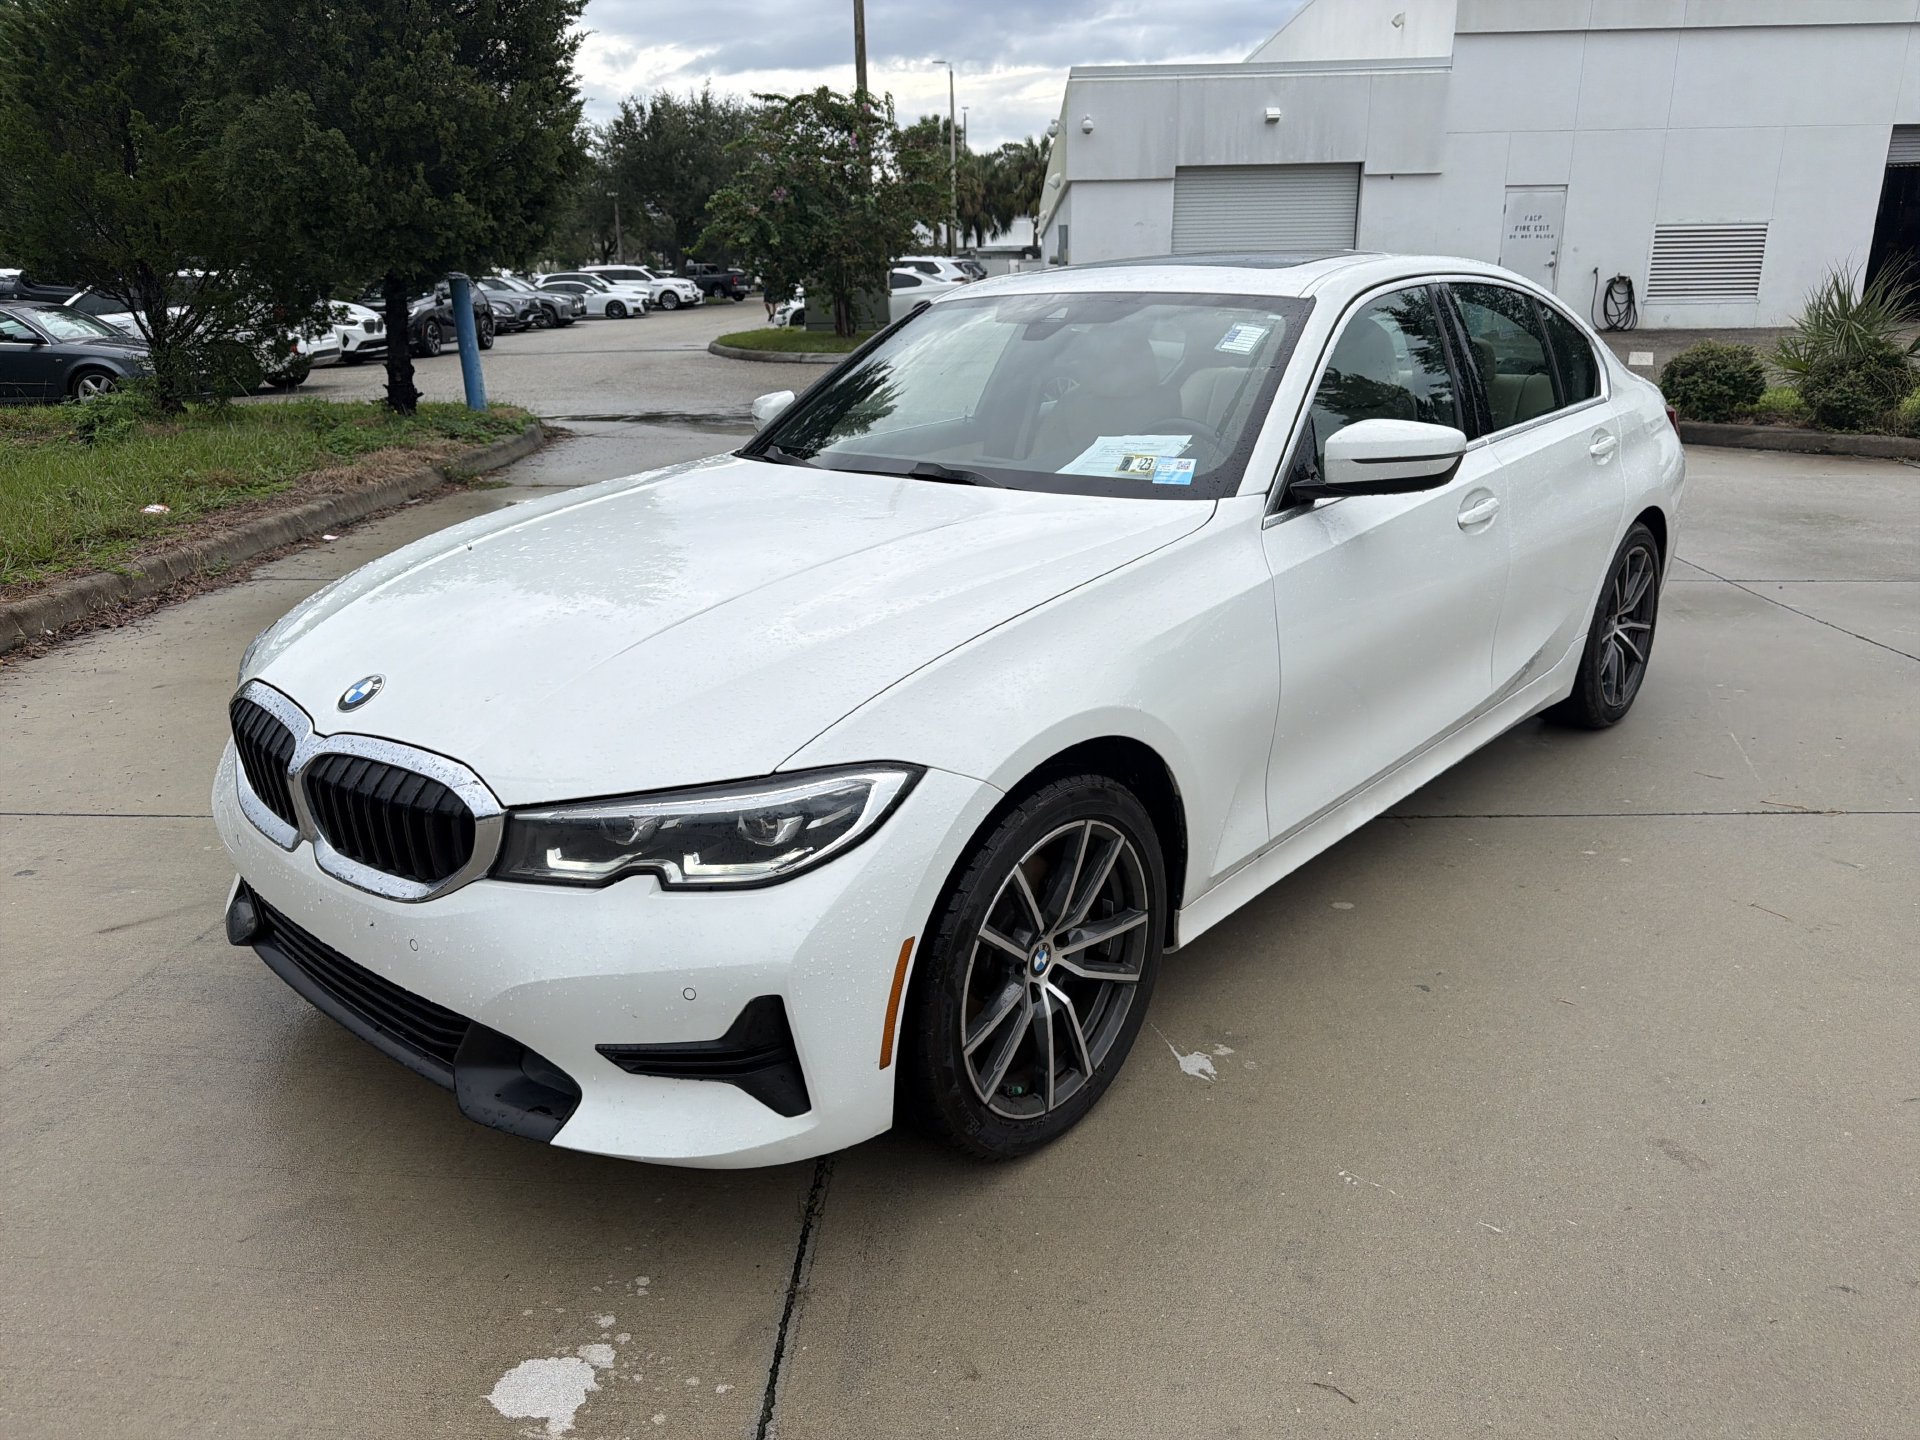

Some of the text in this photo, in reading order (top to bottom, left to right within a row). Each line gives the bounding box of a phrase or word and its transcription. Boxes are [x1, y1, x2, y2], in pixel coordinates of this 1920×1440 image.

[1514, 224, 1550, 232] FIRE EXIT
[1139, 457, 1153, 470] 23
